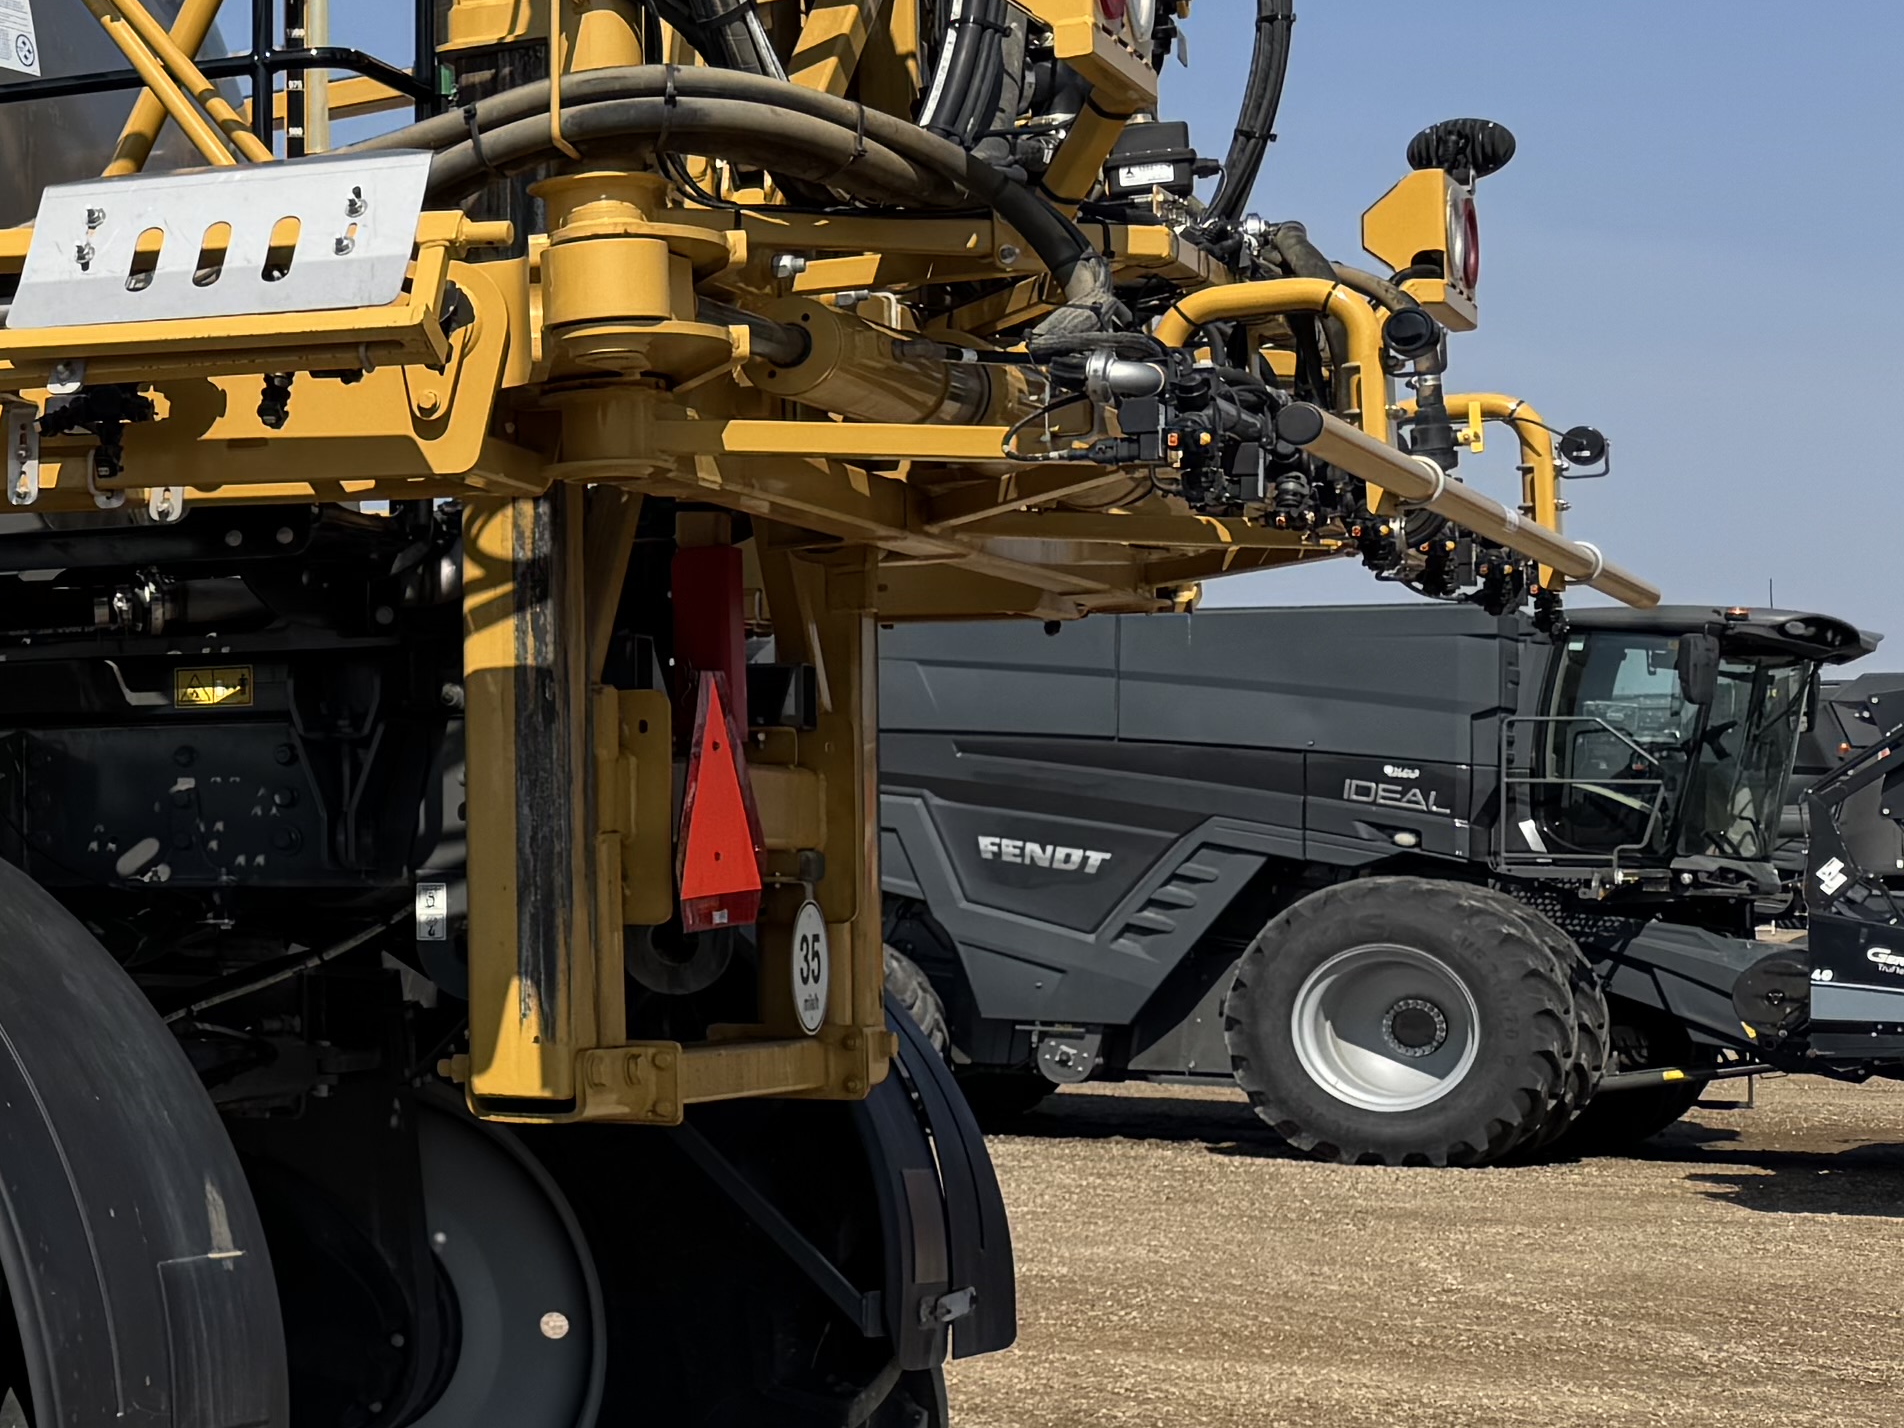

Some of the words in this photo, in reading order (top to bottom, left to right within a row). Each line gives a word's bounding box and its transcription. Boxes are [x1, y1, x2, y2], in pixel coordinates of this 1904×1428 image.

[1343, 778, 1451, 814] IDEAL
[978, 835, 1112, 874] FENDT
[800, 933, 821, 985] 35
